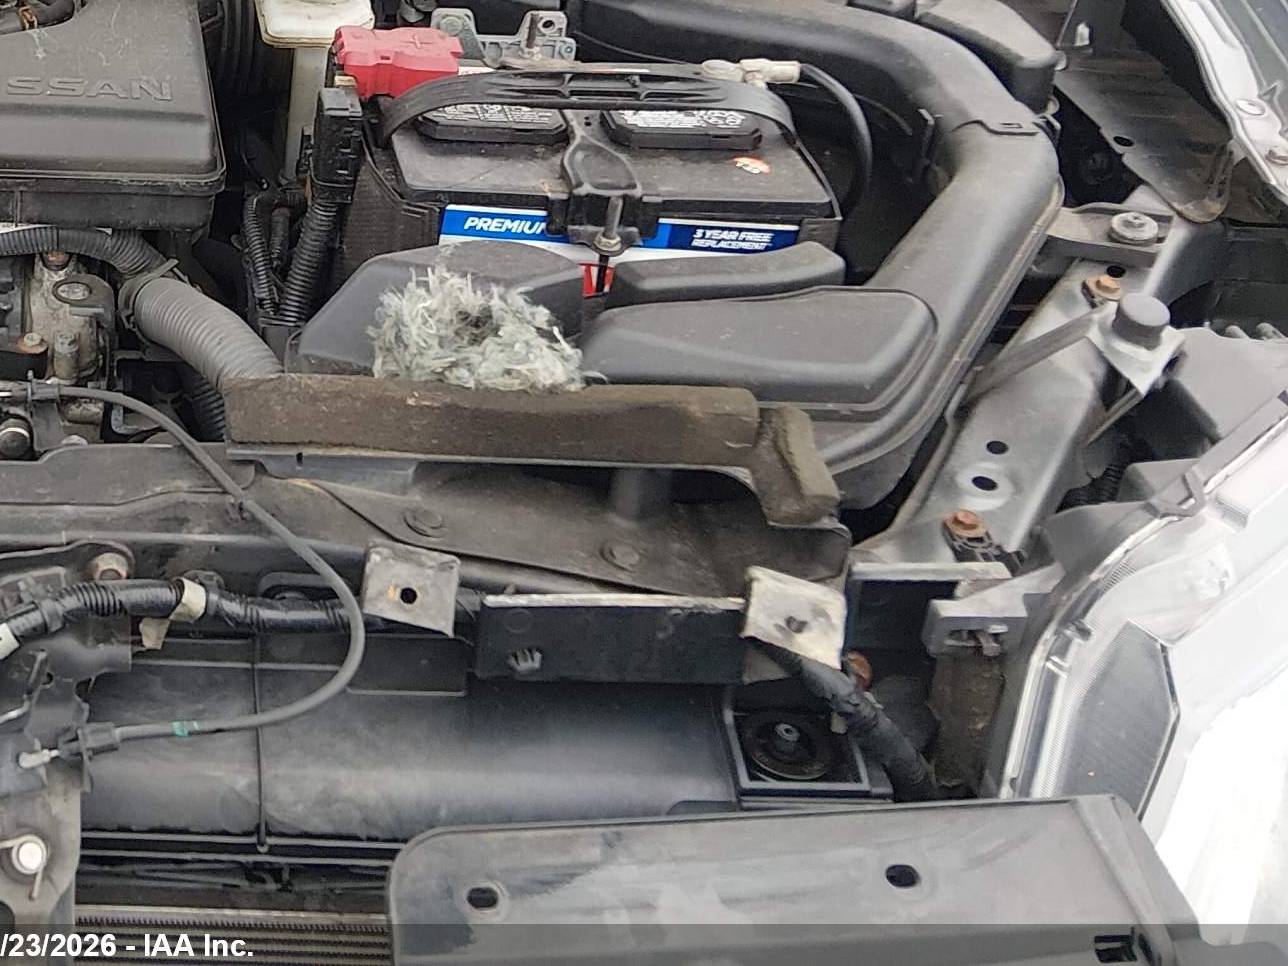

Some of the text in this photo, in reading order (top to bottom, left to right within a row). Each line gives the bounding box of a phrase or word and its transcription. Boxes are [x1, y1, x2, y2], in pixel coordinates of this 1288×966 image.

[693, 229, 774, 242] 3 YEAR FREE
